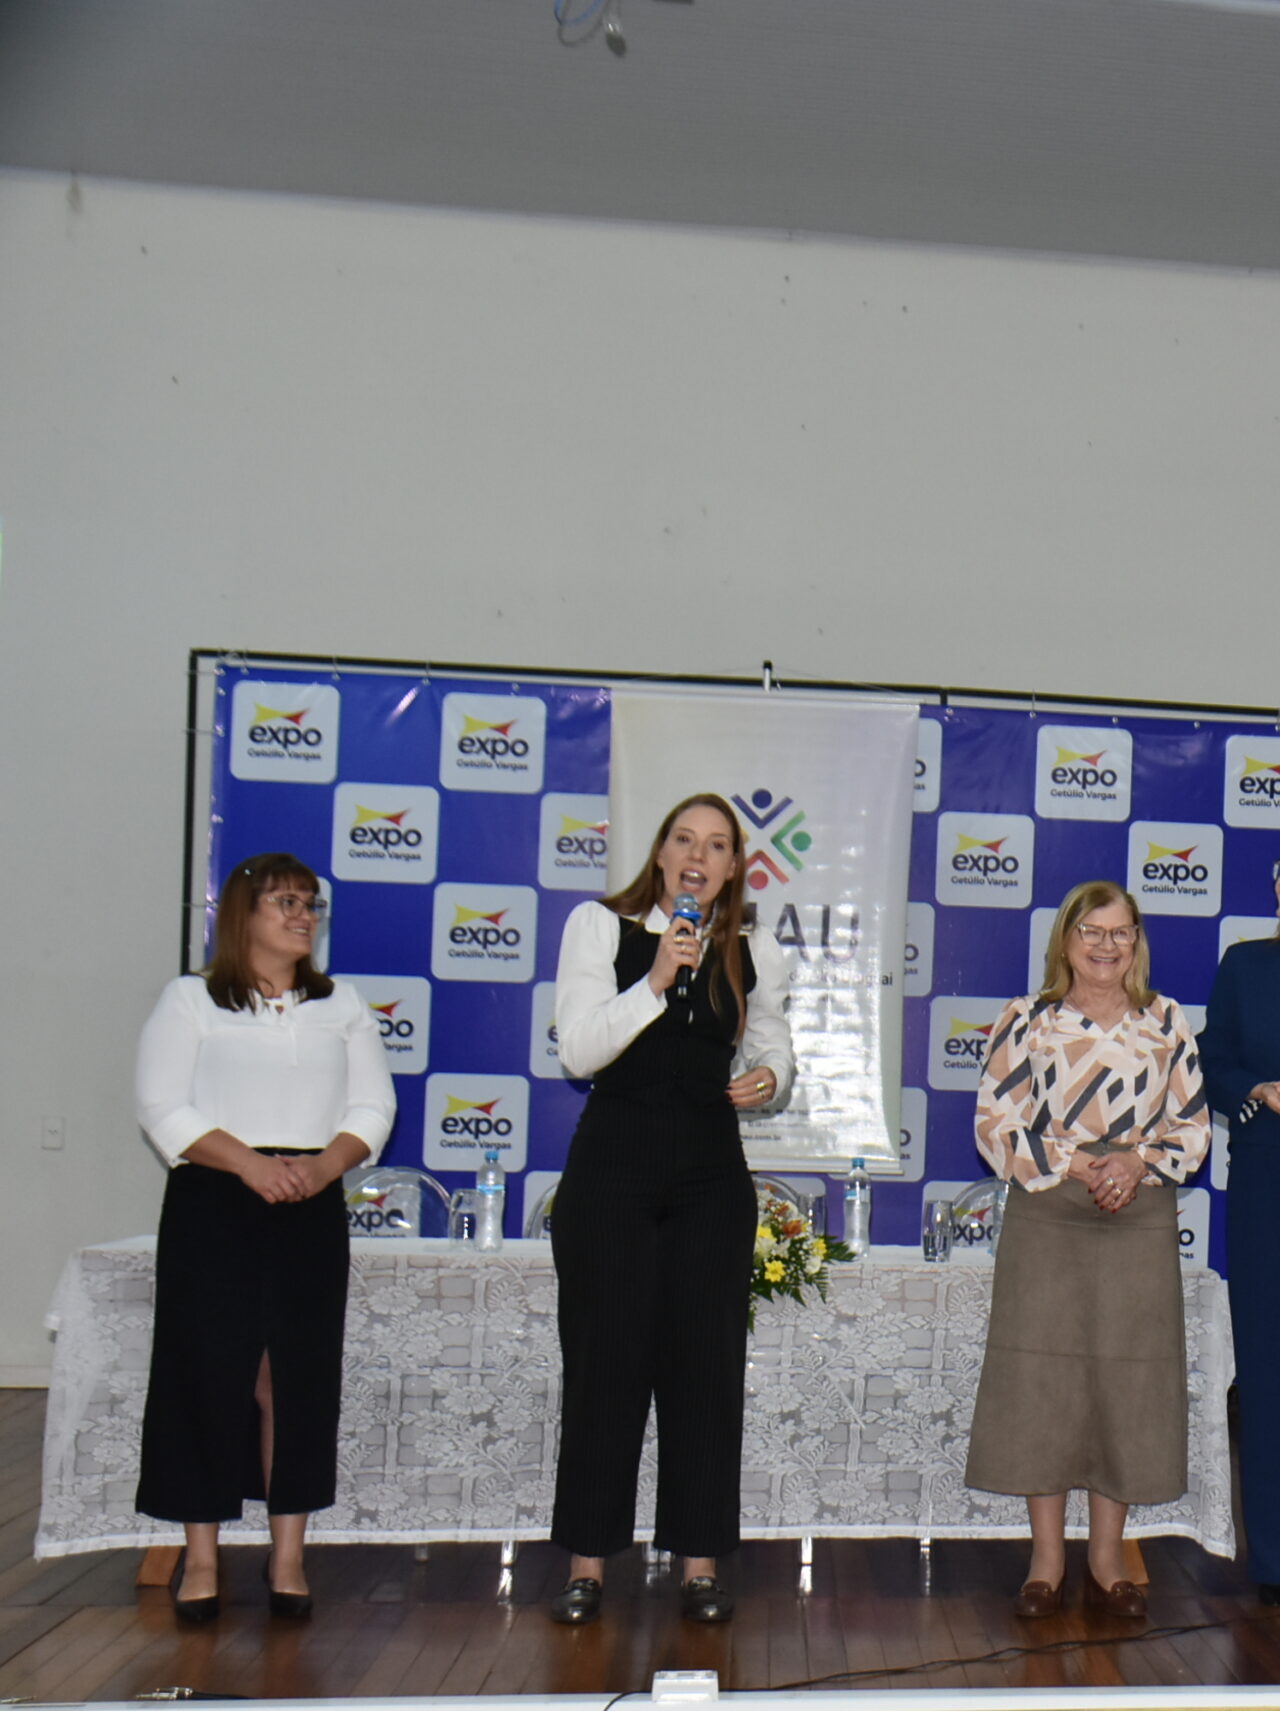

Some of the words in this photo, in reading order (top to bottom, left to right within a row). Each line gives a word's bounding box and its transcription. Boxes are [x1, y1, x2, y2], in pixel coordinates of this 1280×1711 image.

[249, 725, 322, 749] expo
[458, 736, 529, 760] expo
[1051, 767, 1118, 790] expo
[1085, 790, 1118, 801] Vargas
[1239, 798, 1272, 807] Getúlio
[350, 826, 422, 849] expo
[556, 836, 607, 860] exp
[952, 853, 1019, 877] expo
[1143, 863, 1208, 886] expo
[986, 876, 1019, 888] Vargas
[1142, 884, 1175, 894] Getúlio
[1176, 886, 1208, 896] Vargas
[450, 926, 521, 950] expo
[944, 1038, 988, 1061] exp
[441, 1117, 512, 1140] expo
